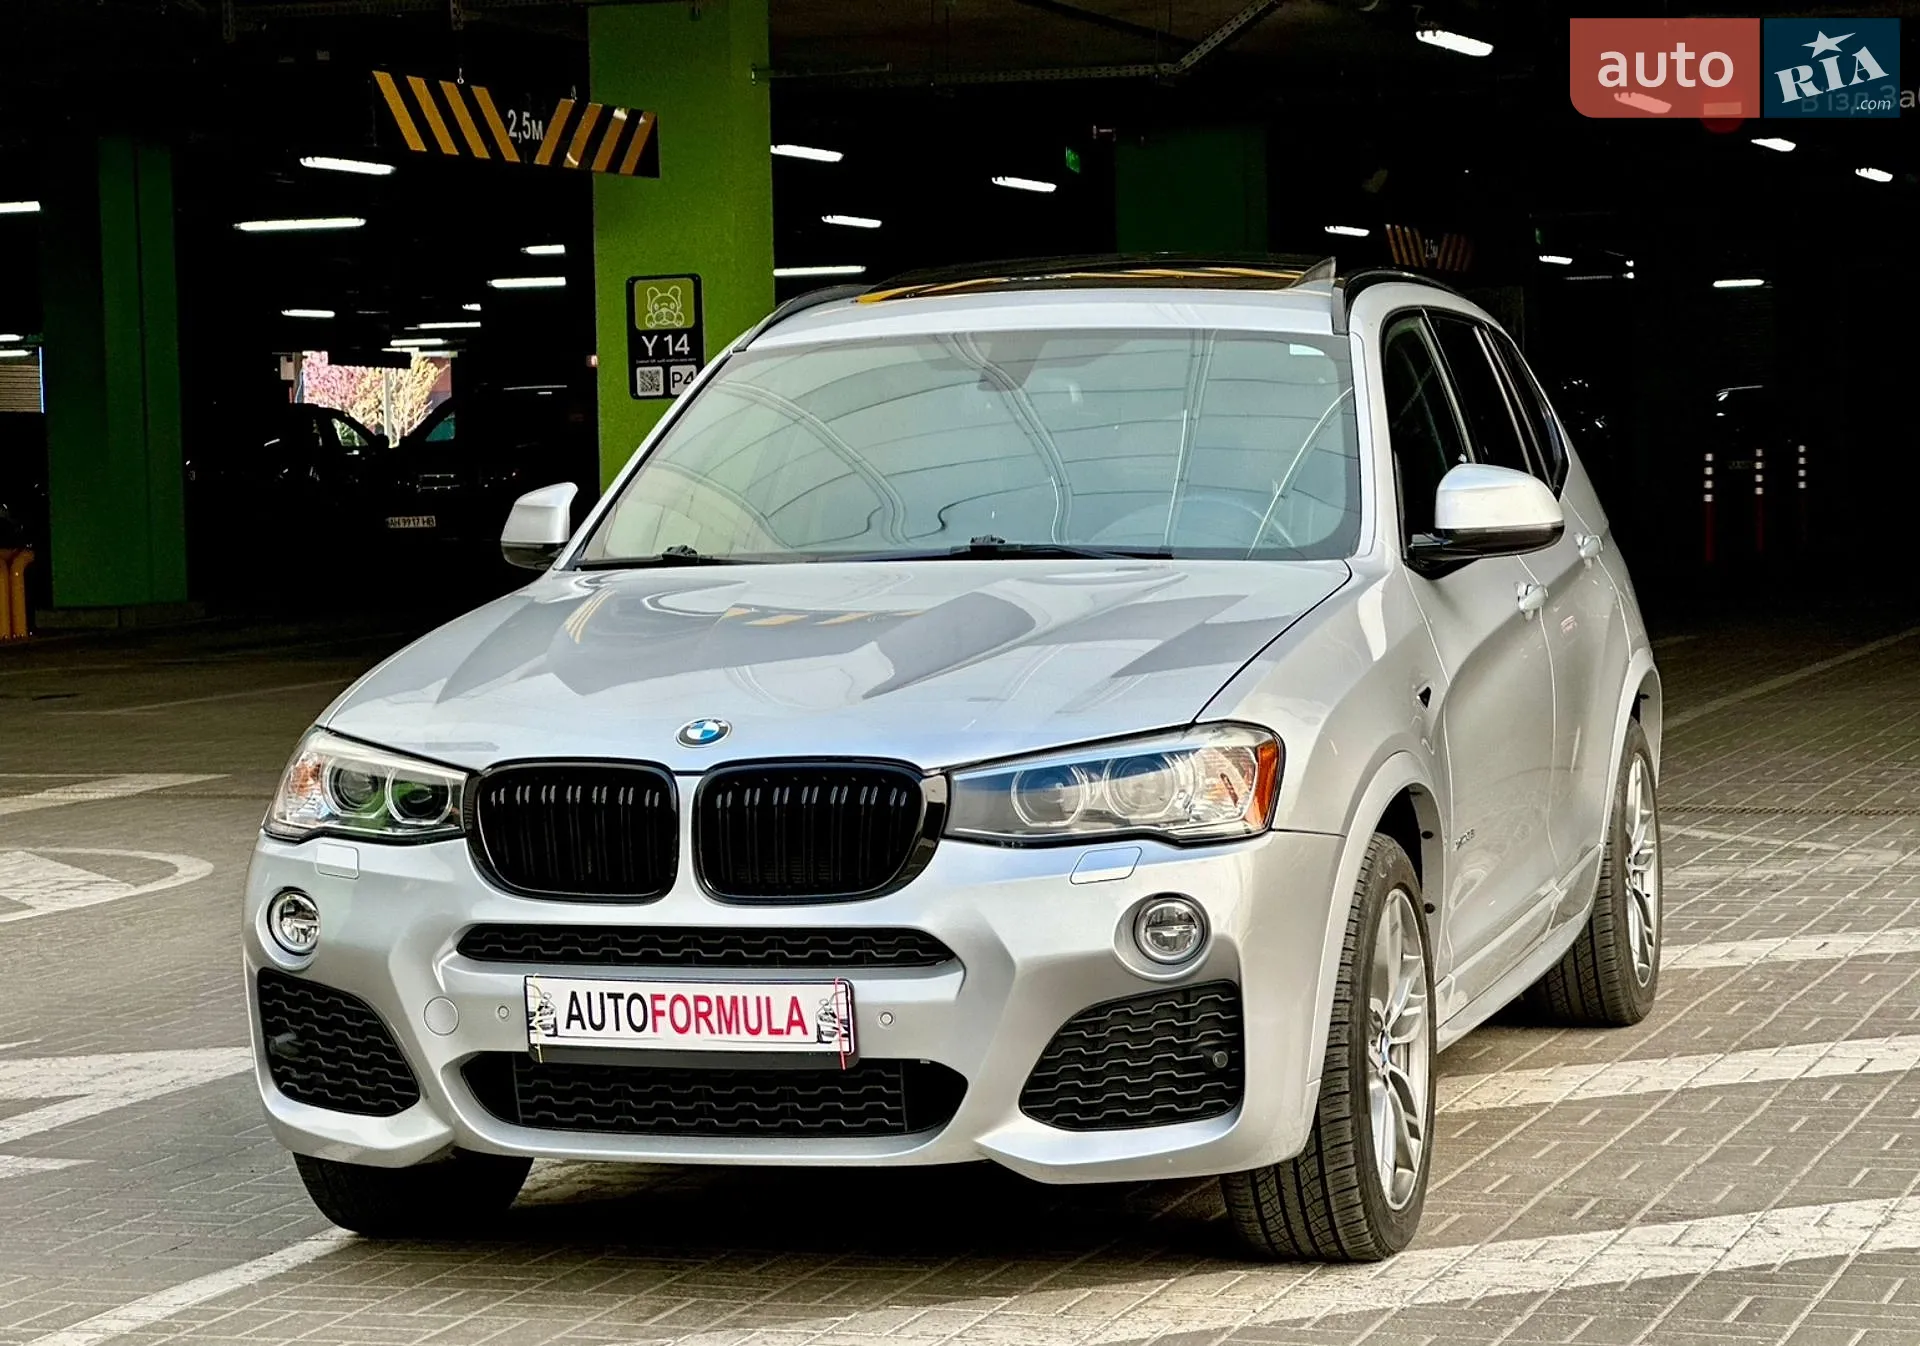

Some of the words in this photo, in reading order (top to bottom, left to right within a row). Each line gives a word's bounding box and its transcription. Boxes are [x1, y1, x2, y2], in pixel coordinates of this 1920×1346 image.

[1880, 84, 1920, 109] За
[641, 334, 658, 356] Y
[663, 333, 690, 355] 14
[671, 371, 695, 388] P4
[566, 990, 808, 1036] AUTOFORMULA
